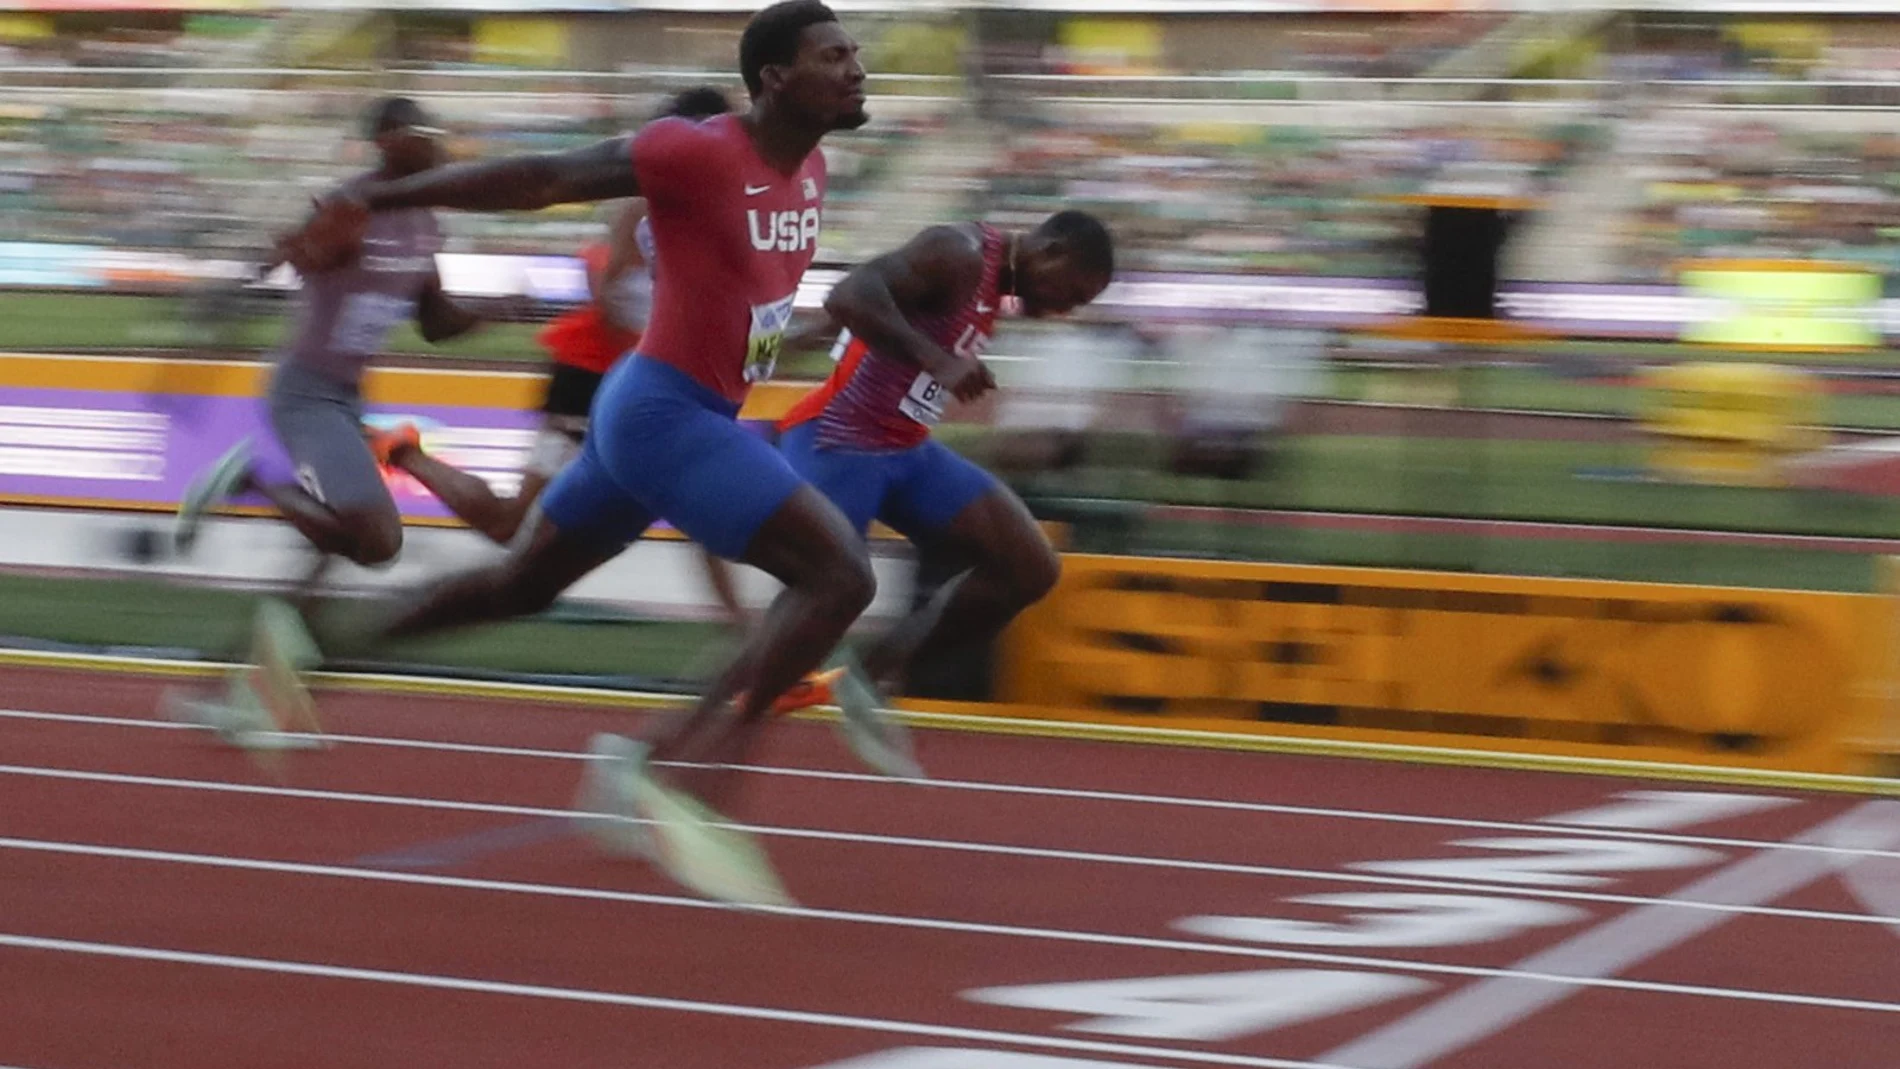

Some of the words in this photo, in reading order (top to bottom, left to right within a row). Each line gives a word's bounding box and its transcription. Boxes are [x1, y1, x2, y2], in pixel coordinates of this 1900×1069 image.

[747, 207, 820, 251] USA
[1170, 892, 1592, 947] 3
[960, 968, 1440, 1041] 4
